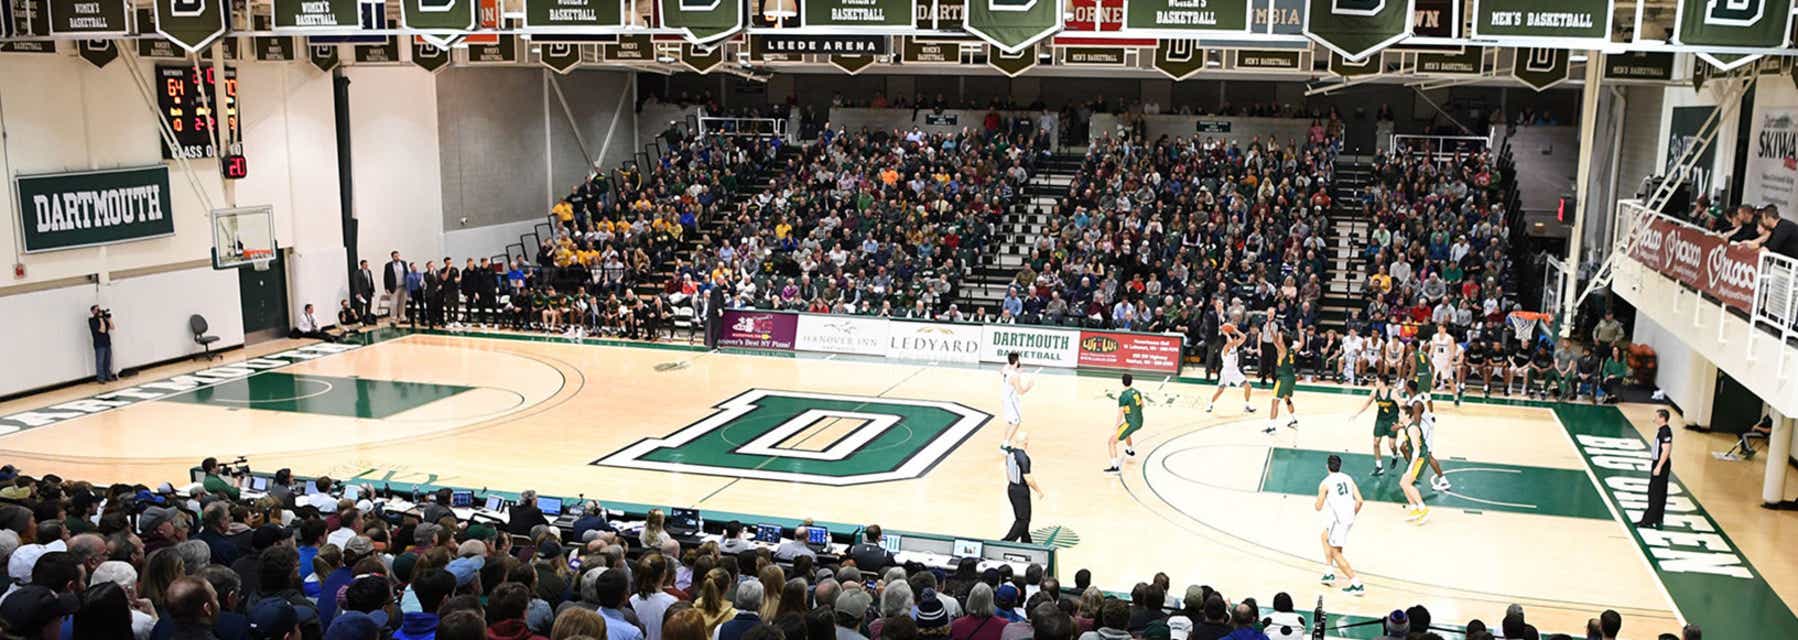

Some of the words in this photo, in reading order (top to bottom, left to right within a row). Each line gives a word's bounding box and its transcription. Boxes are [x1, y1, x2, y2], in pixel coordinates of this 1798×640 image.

[301, 1, 331, 13] WOMEN'S
[549, 9, 597, 21] BASKETBALL
[831, 8, 885, 21] BASKETBALL
[69, 17, 109, 29] BASKETBALL
[295, 13, 338, 25] BASKETBALL
[1156, 11, 1216, 25] BASKETBALL
[1251, 8, 1300, 25] MBIA
[1490, 11, 1522, 26] MEN'S
[1526, 12, 1593, 28] BASKETBALL
[767, 41, 816, 51] LEEDE
[823, 41, 877, 51] ARENA
[167, 79, 185, 96] 64
[229, 157, 246, 177] 20
[33, 184, 163, 232] DARTMOUTH
[803, 335, 850, 346] HANOVER
[856, 337, 878, 347] INN
[890, 336, 979, 353] LEDYARD
[993, 331, 1070, 350] DARTMOUTH
[996, 349, 1063, 361] BAKETBALL
[590, 388, 996, 488] D
[1575, 434, 1656, 474] BIG
[1336, 481, 1348, 496] 21
[1603, 475, 1755, 579] GREEN
